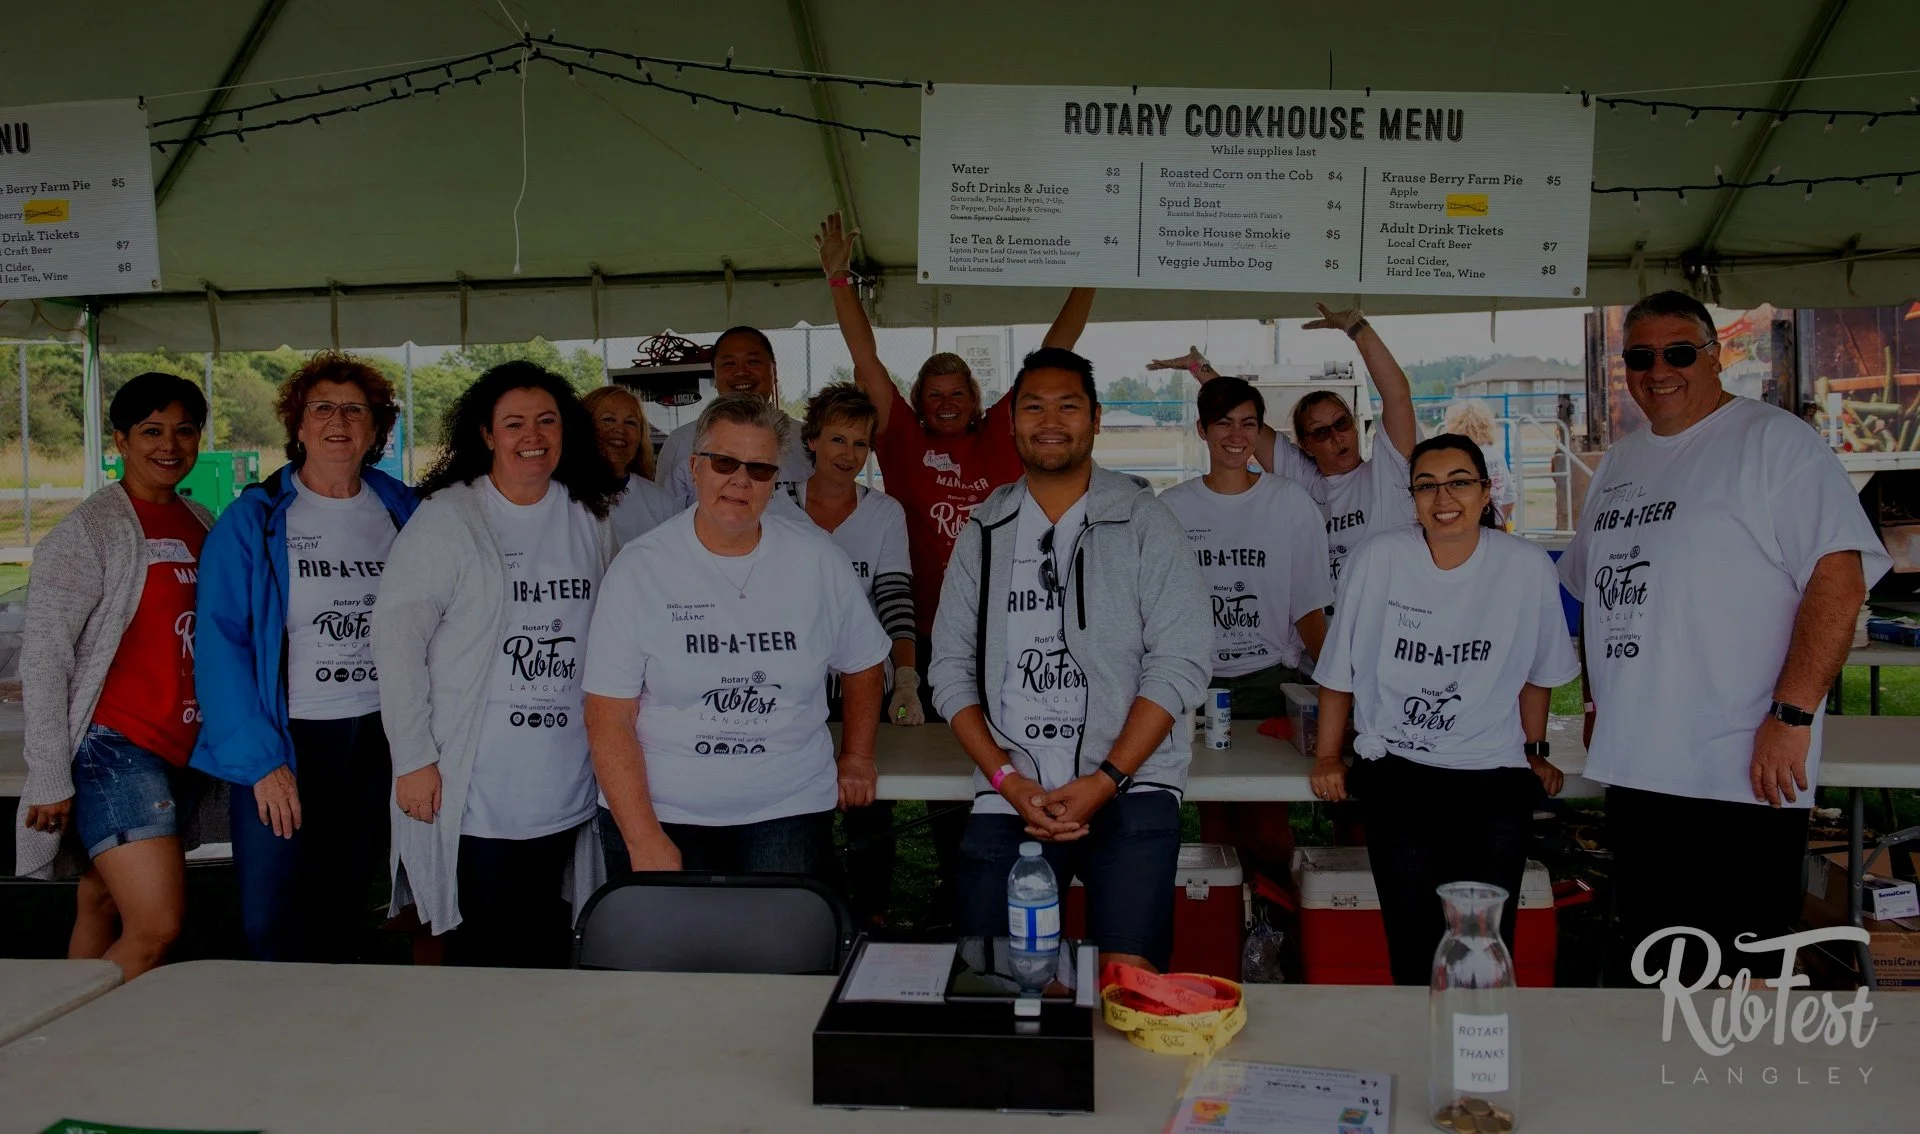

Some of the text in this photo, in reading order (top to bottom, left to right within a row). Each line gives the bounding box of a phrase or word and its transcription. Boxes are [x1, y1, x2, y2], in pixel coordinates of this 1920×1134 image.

[1064, 101, 1464, 142] ROTARY COOKHOUSE MENU
[1211, 145, 1317, 157] While supplies last
[952, 163, 1121, 177] Water $2
[1160, 167, 1343, 181] Roasted Corn on the Cob $4
[1381, 172, 1561, 186] Krause Berry Farm Pie $5
[6, 178, 125, 196] Berry Farm Pie $5
[951, 182, 1120, 195] Soft Drinks & Juice $3
[1389, 187, 1419, 198] Apple
[961, 205, 987, 213] Pepper,
[1005, 206, 1026, 214] Apple
[1159, 197, 1342, 212] Spud Boat $4
[1389, 200, 1444, 212] Strawberry
[1158, 226, 1340, 240] Smoke House Smokie $5
[1379, 223, 1504, 236] Adult Drink Tickets
[2, 230, 79, 243] Drink Tickets
[949, 234, 1119, 246] Ice Tea & Lemonade $4
[4, 240, 129, 256] Craft Beer $7
[1166, 240, 1174, 248] by
[1387, 239, 1557, 252] Local Craft Beer $7
[949, 247, 972, 255] Lipton
[1059, 249, 1080, 257] honey
[949, 256, 972, 264] Lipton
[1157, 256, 1339, 271] Veggie Jumbo Dog $5
[1387, 256, 1449, 267] Local Cider,
[5, 263, 131, 273] Cider, $8
[1386, 265, 1556, 279] Hard Ice Tea, Wine $8
[4, 273, 68, 283] Ice Tea, Wine
[1326, 510, 1365, 534] TEER
[1594, 501, 1677, 531] RIB-A-TEER
[1198, 549, 1266, 568] IB-A-TEER
[1609, 552, 1628, 561] Rotary
[298, 559, 385, 578] RIB-A-TEE
[513, 578, 591, 603] IB-A-TEER
[333, 599, 361, 607] Rotary
[313, 610, 373, 641] RibFe
[522, 624, 550, 632] Rotary
[686, 631, 797, 654] RIB-A-TEER
[503, 635, 576, 681] RibFest
[1394, 638, 1492, 666] RIB-A-TEER
[721, 675, 750, 685] Rotary
[1458, 1025, 1504, 1037] ROTARY
[1460, 1047, 1504, 1059] THANKS
[1471, 1072, 1496, 1083] YOU
